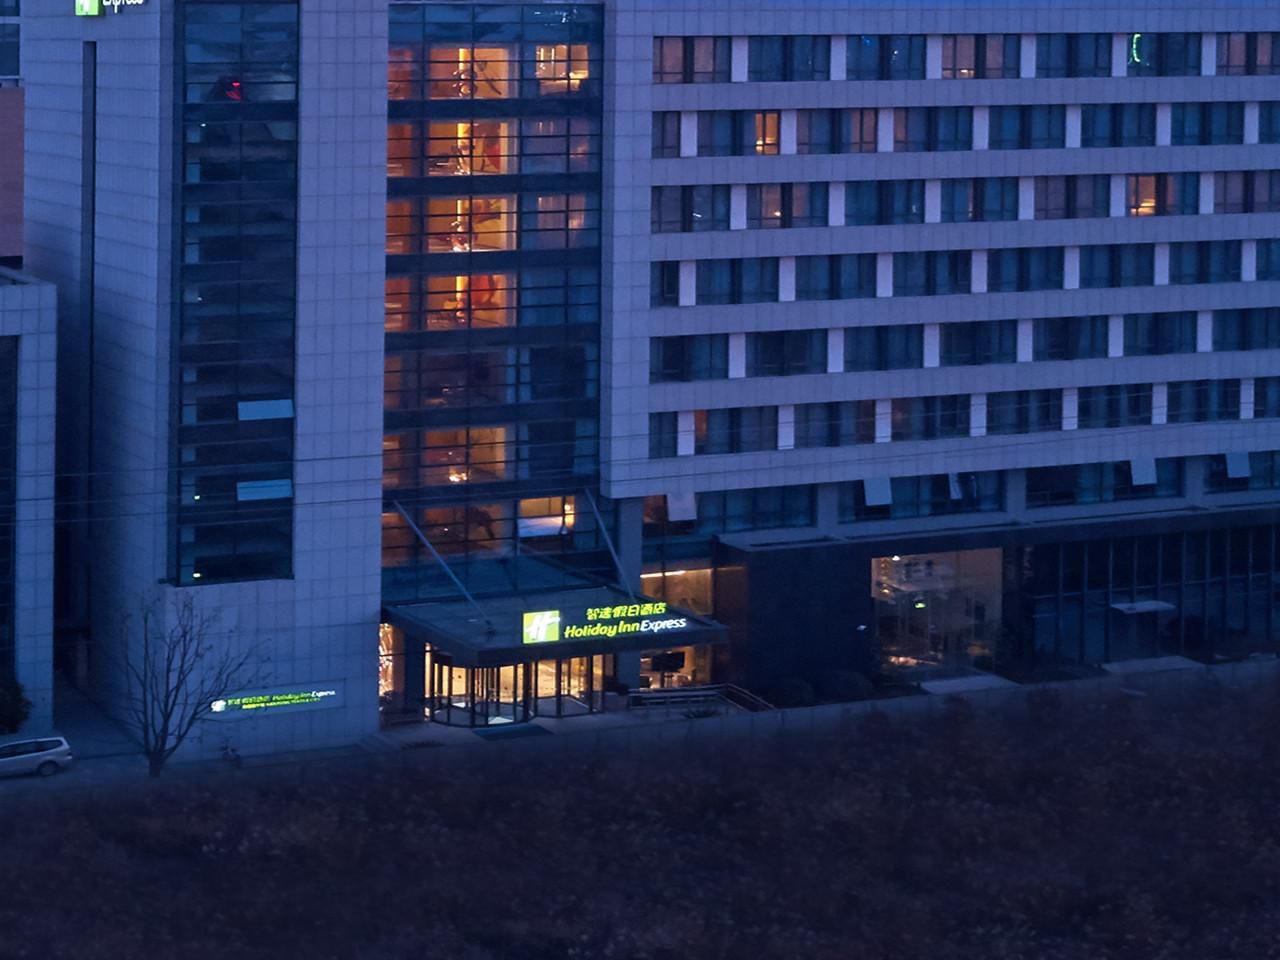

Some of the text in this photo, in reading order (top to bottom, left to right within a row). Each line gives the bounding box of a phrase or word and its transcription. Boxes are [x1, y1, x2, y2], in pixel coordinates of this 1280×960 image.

[564, 623, 618, 639] Holiday
[618, 620, 640, 633] Inn
[640, 618, 687, 633] Express
